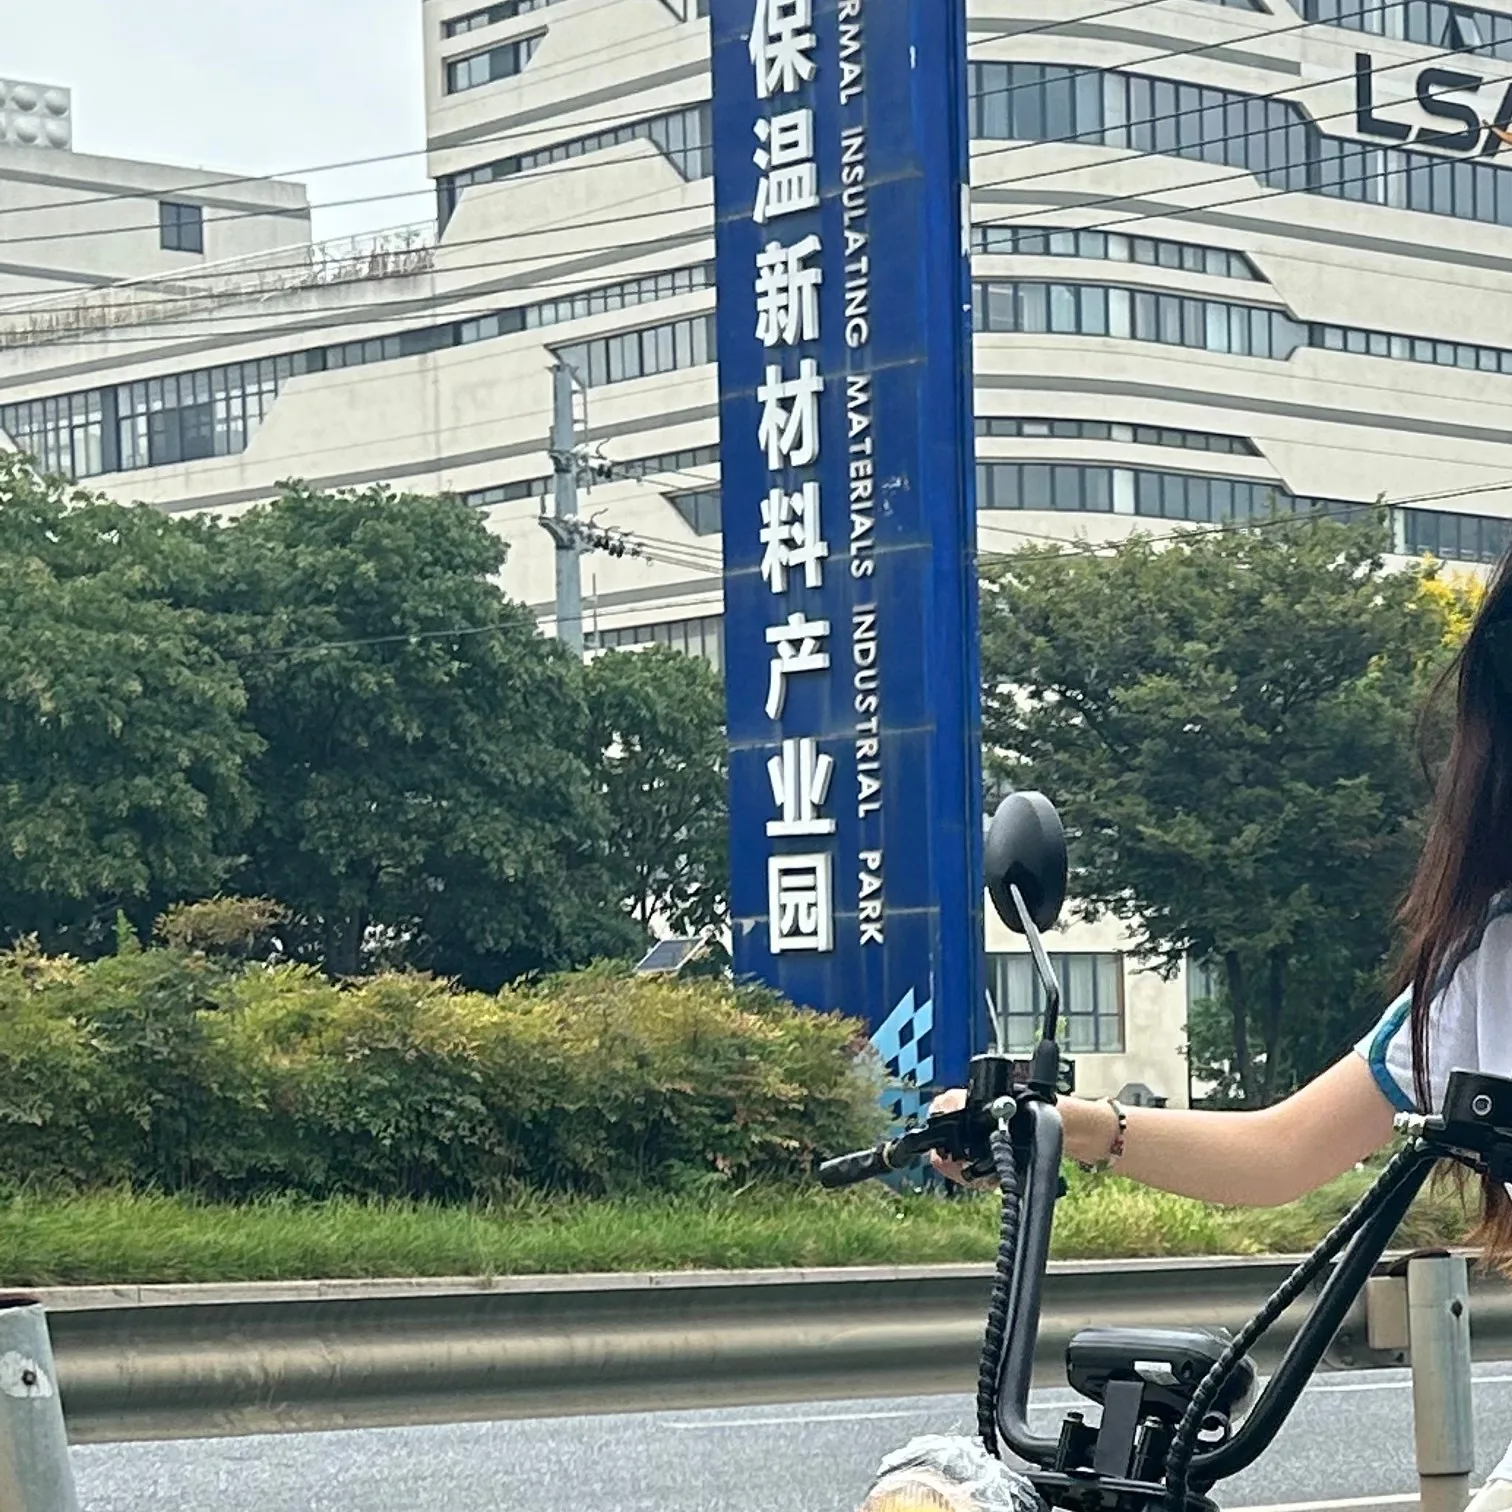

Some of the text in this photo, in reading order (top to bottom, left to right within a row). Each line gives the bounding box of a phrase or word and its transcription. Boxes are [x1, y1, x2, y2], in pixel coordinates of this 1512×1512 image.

[841, 126, 869, 348] INSULATING
[749, 0, 836, 954] 保温新材料产业园
[846, 375, 875, 578] MATERIALS
[852, 603, 883, 819] INDUSTRIAL
[858, 850, 885, 945] PARK
